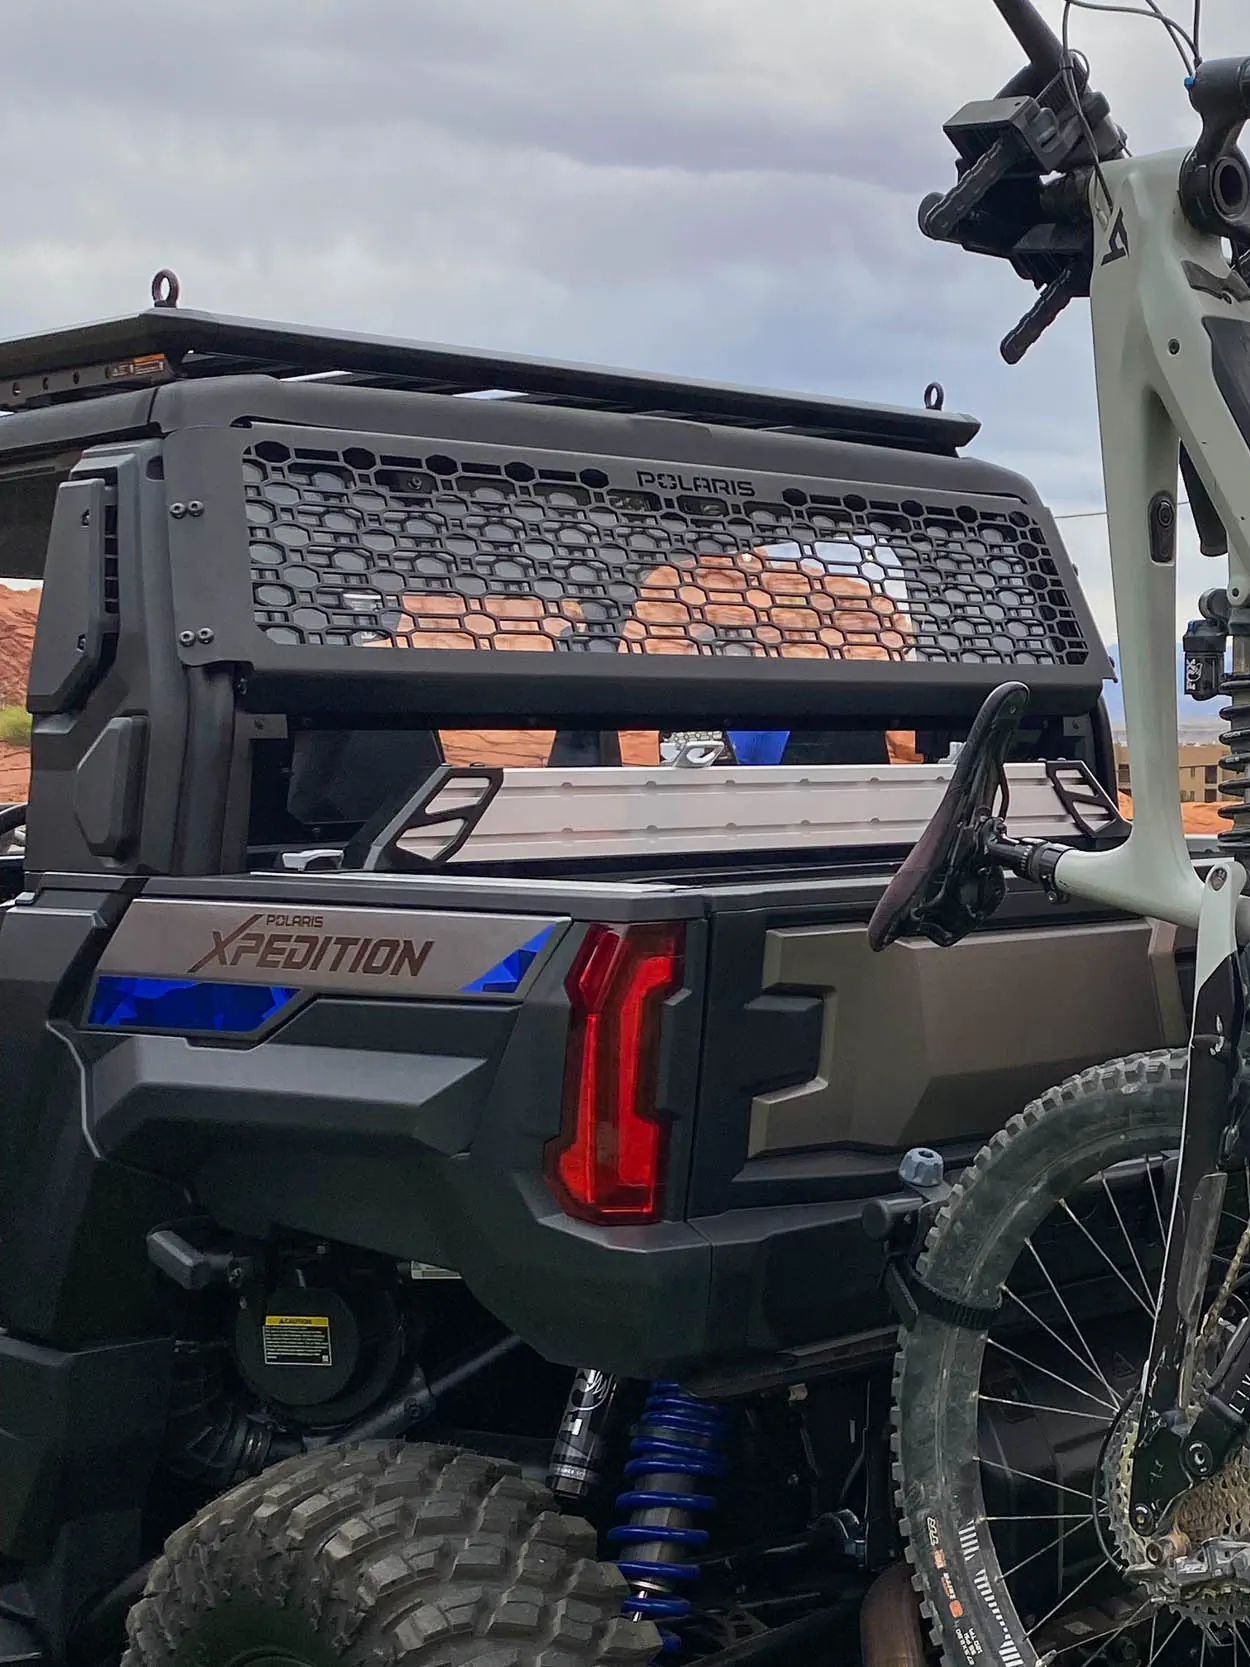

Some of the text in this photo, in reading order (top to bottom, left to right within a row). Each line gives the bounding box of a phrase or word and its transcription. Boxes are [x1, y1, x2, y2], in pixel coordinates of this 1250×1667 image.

[636, 470, 756, 497] POLARIS
[266, 914, 324, 928] POLARIS
[187, 913, 436, 977] XPEDITION
